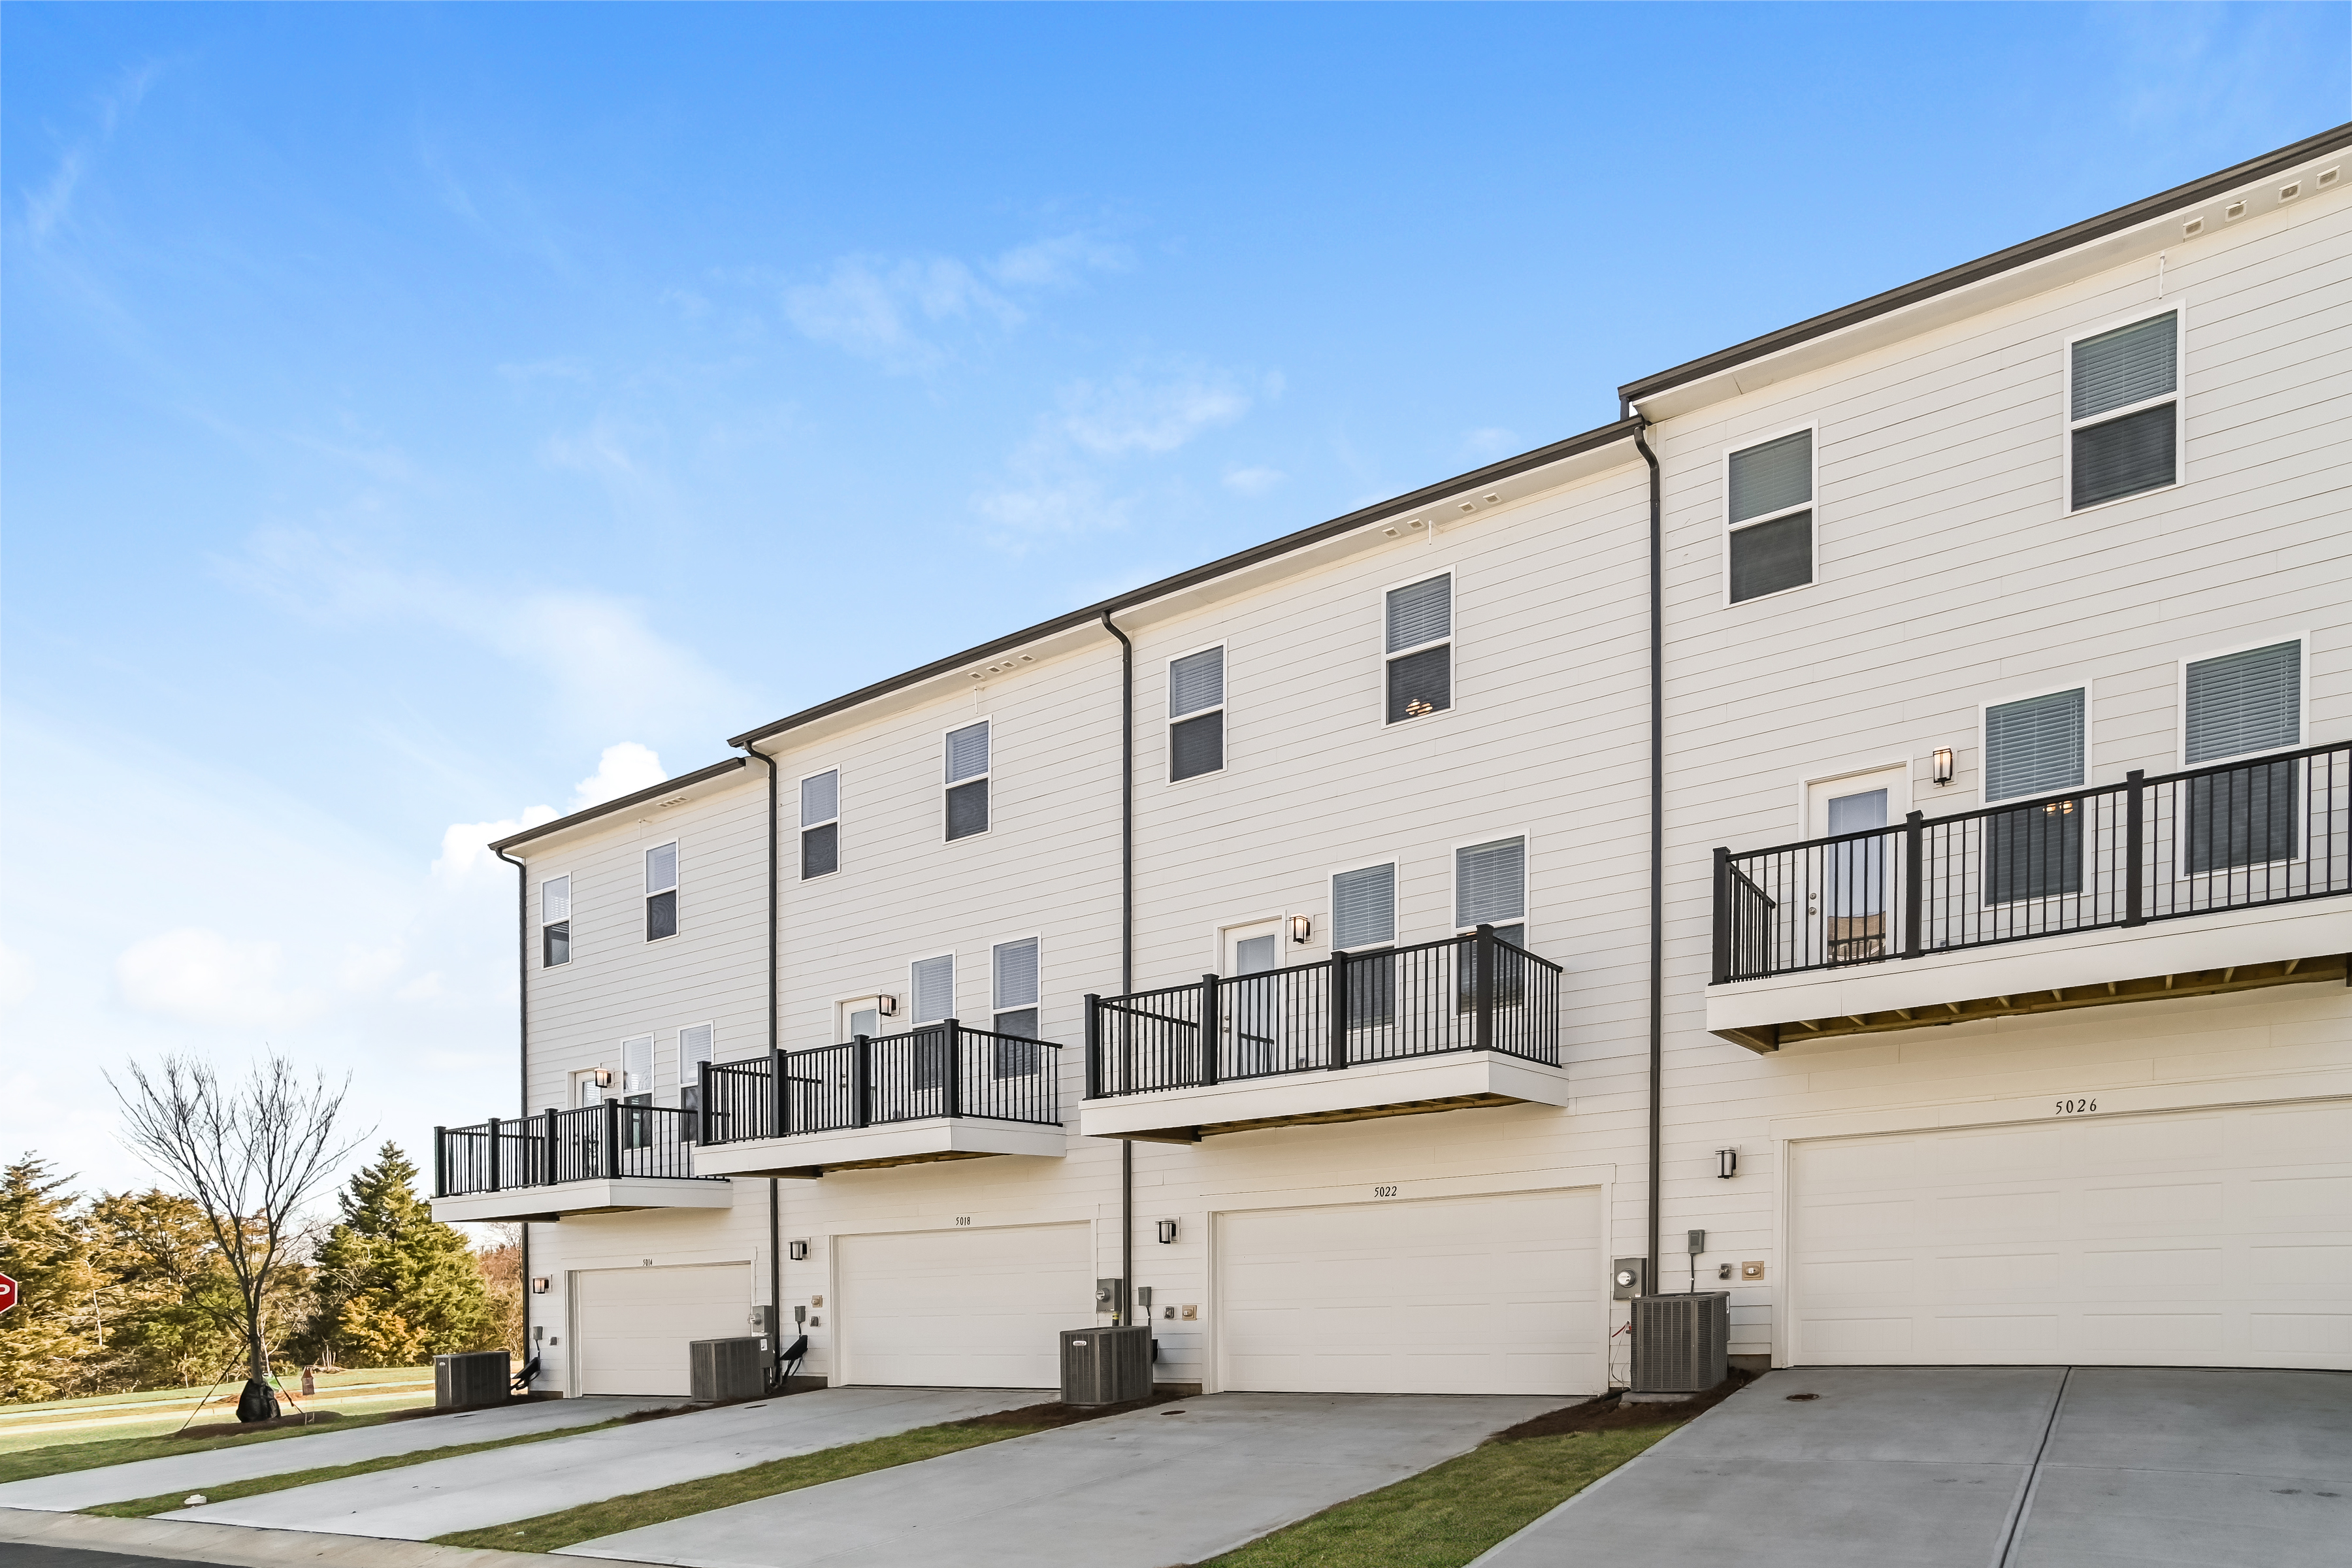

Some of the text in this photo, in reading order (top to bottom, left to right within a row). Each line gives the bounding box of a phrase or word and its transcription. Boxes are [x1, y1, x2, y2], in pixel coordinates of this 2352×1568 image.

[2055, 1098, 2097, 1115] 5026
[1374, 1186, 1397, 1198] 5022
[956, 1217, 970, 1226] 5018
